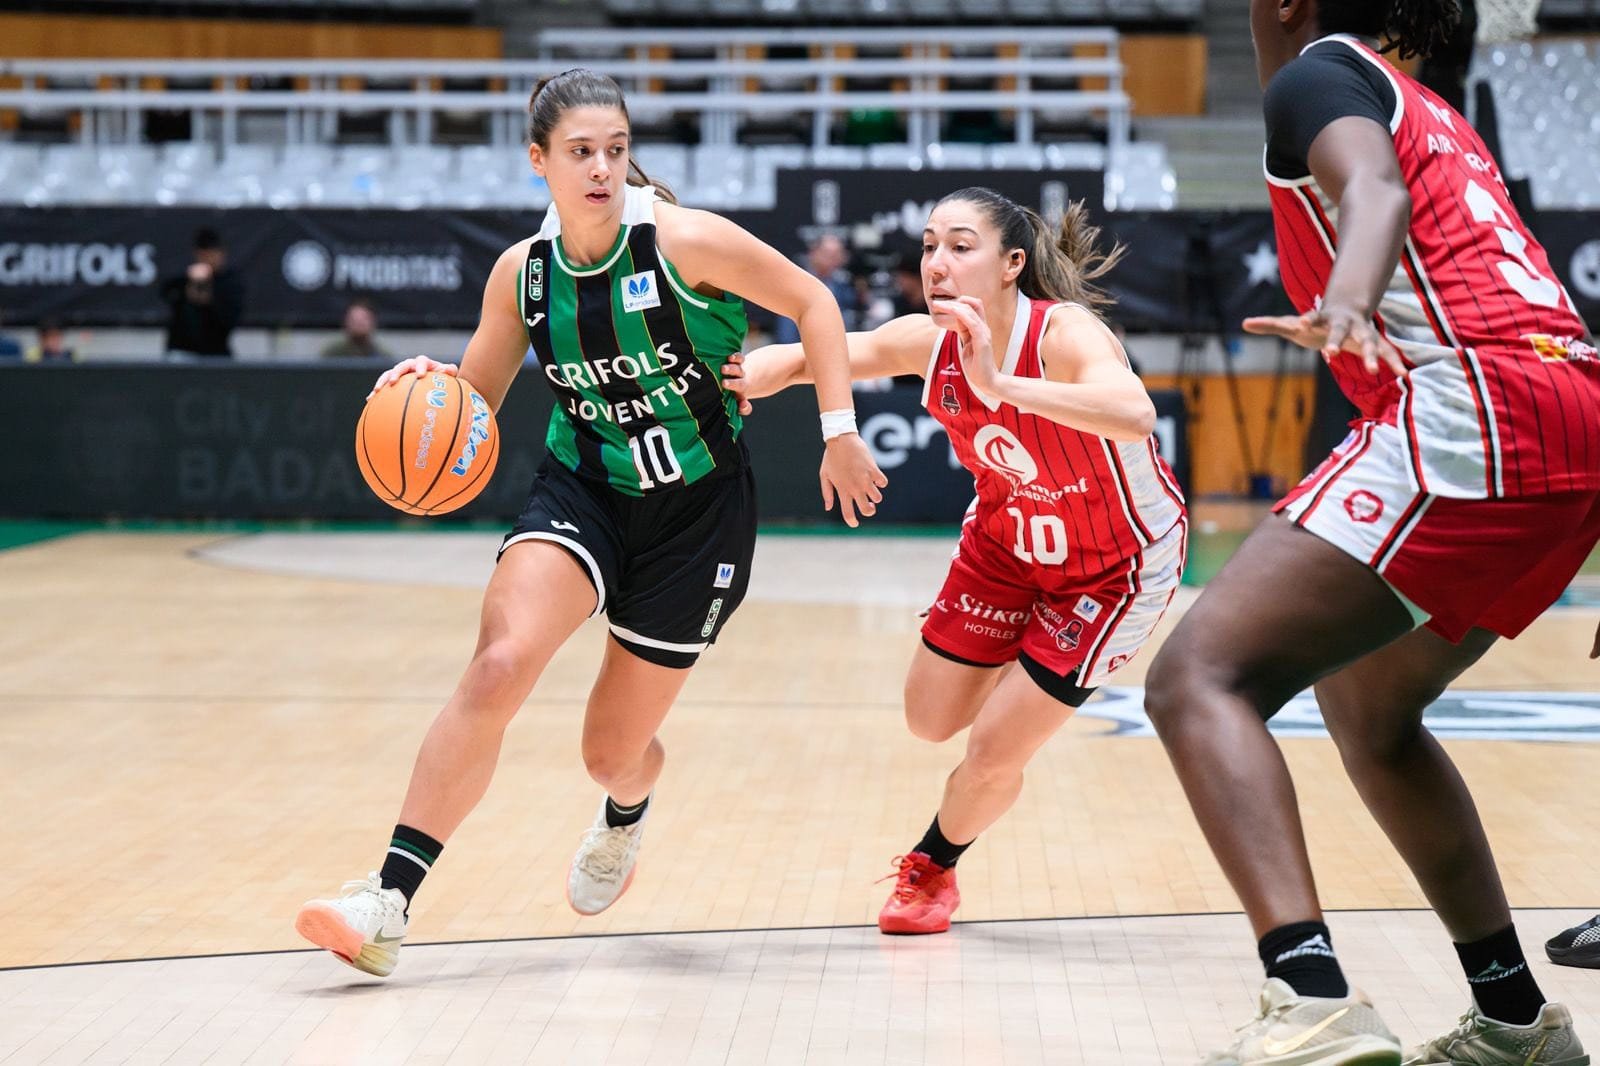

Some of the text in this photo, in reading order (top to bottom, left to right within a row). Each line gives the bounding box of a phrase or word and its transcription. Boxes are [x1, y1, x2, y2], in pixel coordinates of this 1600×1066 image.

[568, 362, 702, 424] JOVENTUT
[628, 425, 683, 490] 10
[1006, 507, 1069, 566] 10
[964, 621, 1016, 640] HOTELES
